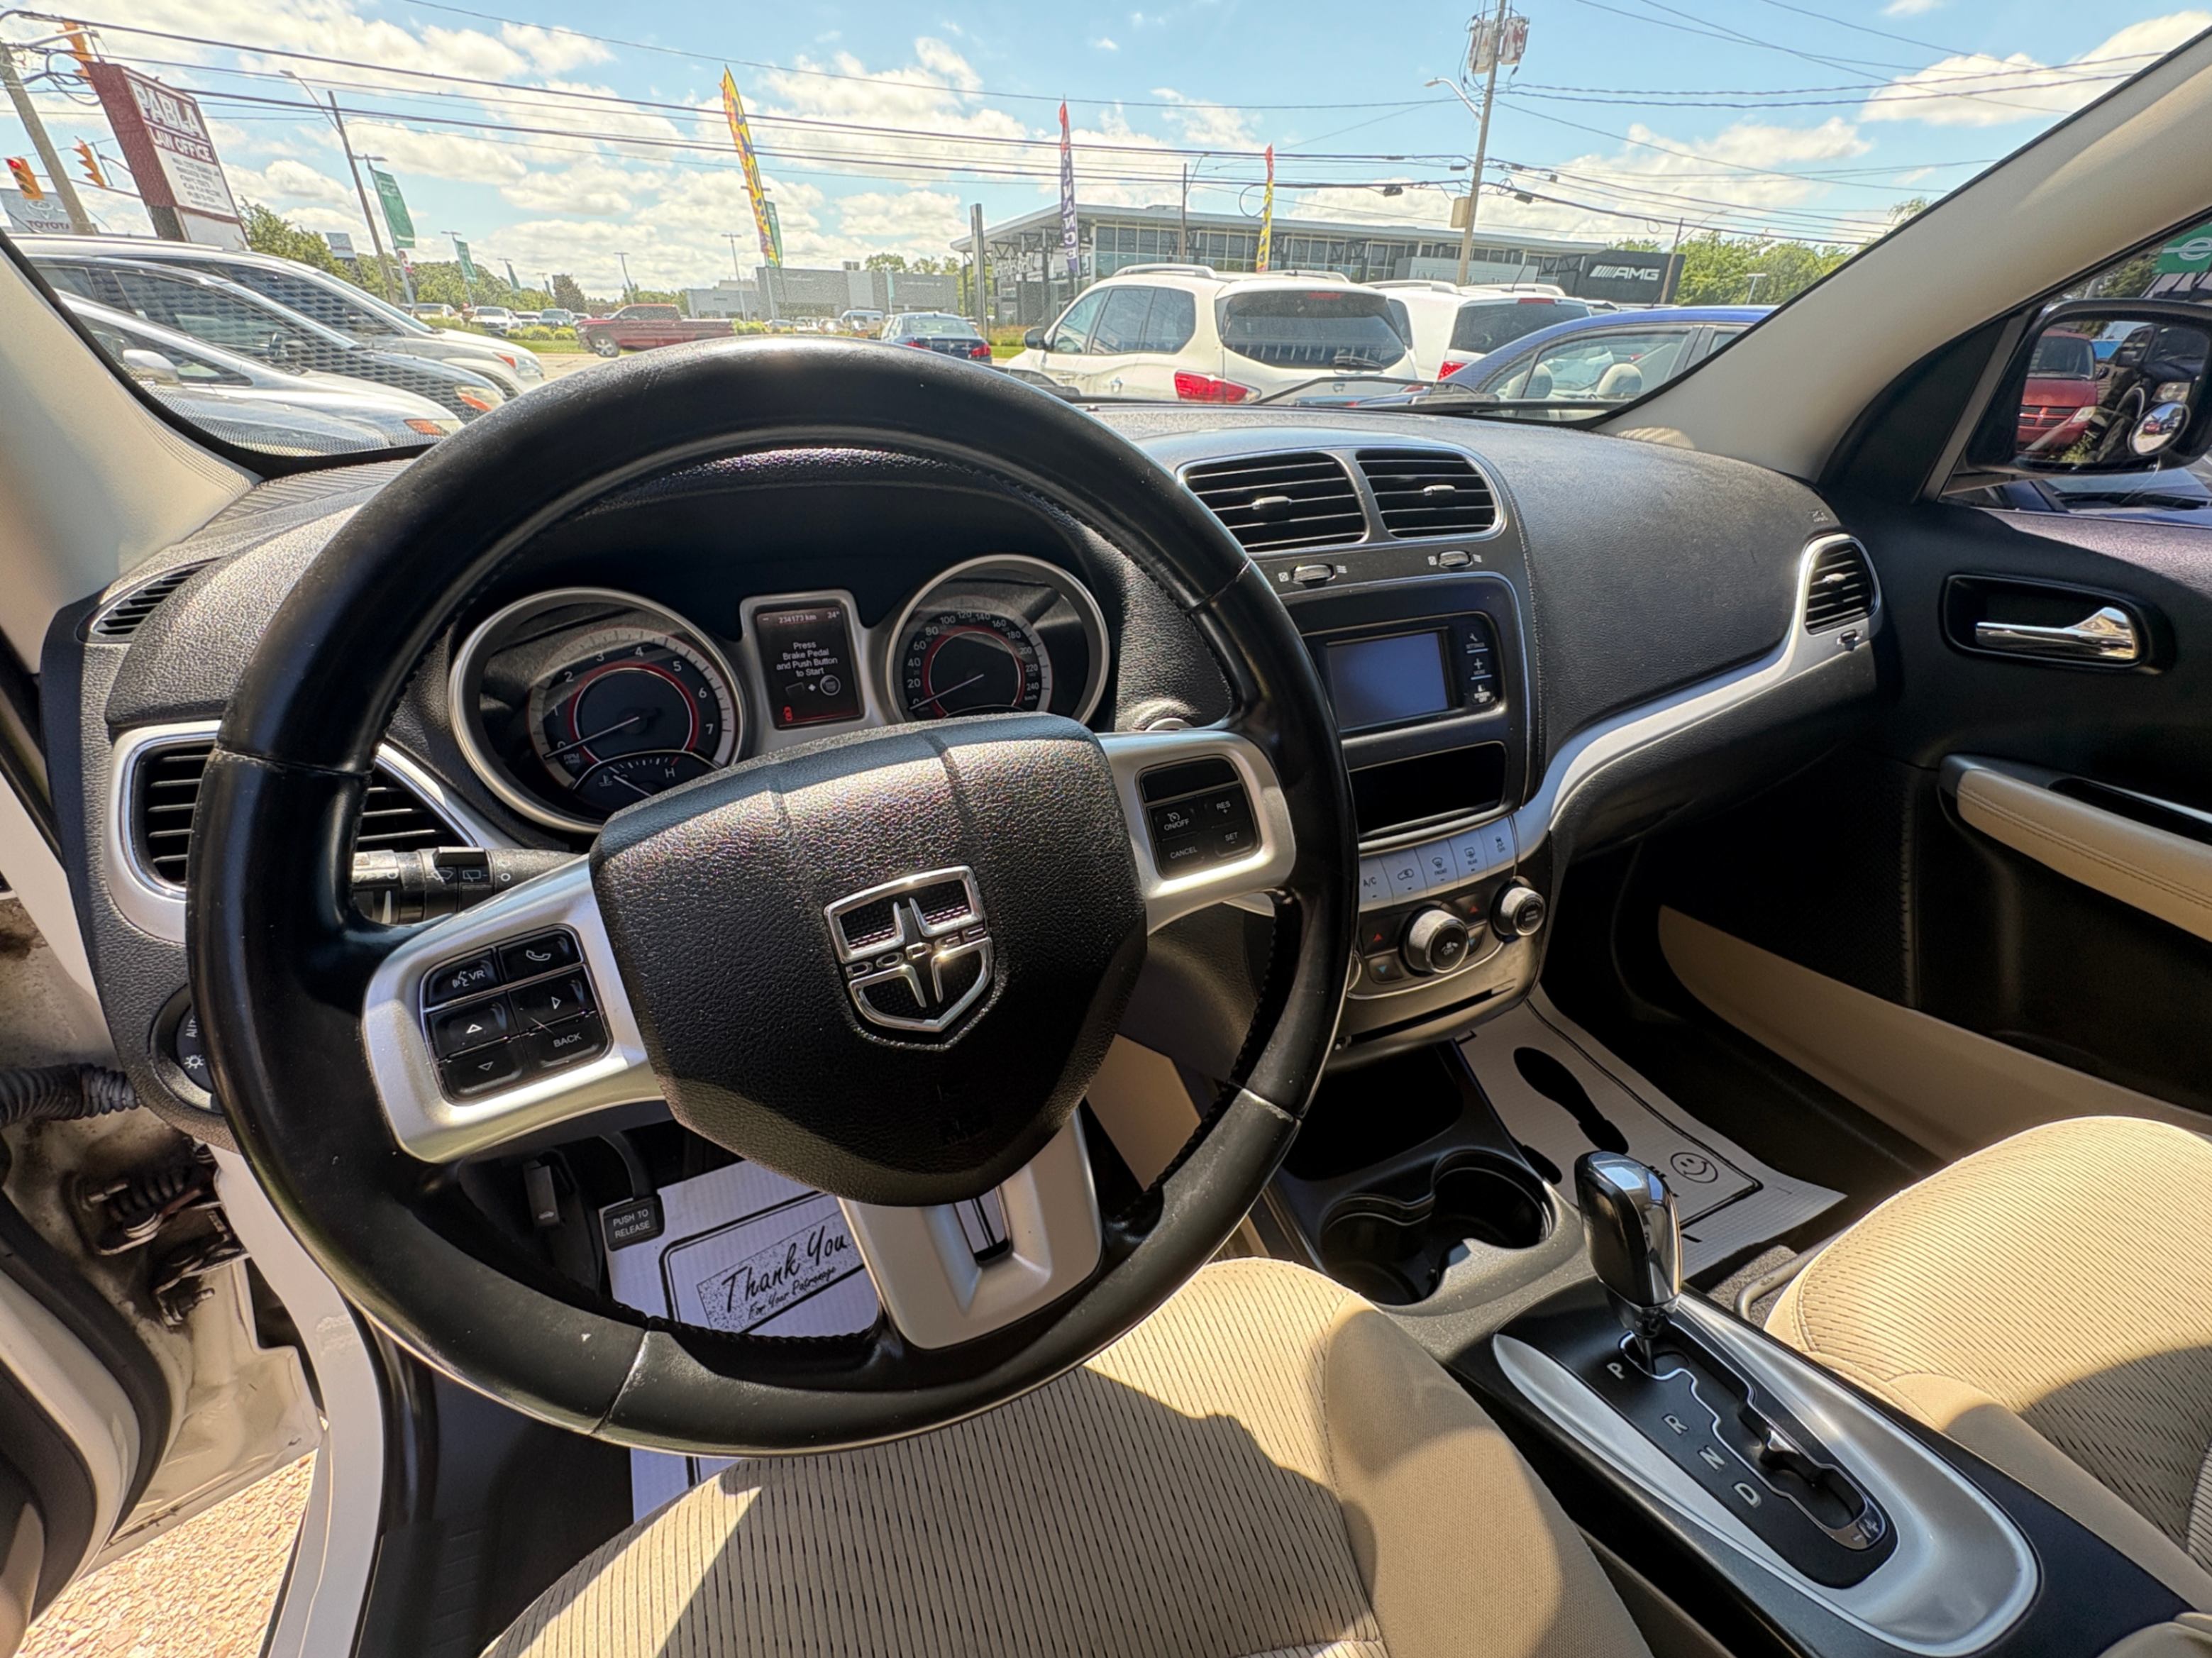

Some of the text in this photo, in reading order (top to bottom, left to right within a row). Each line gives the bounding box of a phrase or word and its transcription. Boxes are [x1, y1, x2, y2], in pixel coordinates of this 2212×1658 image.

[129, 81, 206, 140] PABLA
[149, 126, 212, 162] LAW OFFICE
[1613, 265, 1661, 282] AMG
[940, 615, 956, 624] 100
[925, 626, 939, 636] 80
[634, 646, 644, 657] 4
[792, 641, 817, 650] Press
[913, 641, 927, 651] 60
[596, 652, 605, 661] 3
[783, 648, 829, 661] Brake Pedal
[673, 661, 682, 672] 5
[776, 657, 838, 670] and Push Button
[907, 657, 921, 667] 40
[564, 671, 574, 682] 2
[805, 667, 825, 676] Start
[907, 678, 922, 688] 20
[698, 687, 707, 699] 6
[705, 723, 714, 735] 7
[664, 767, 675, 778] H
[1216, 800, 1231, 810] RES
[1163, 818, 1190, 831] ON/OFF
[1225, 831, 1239, 842] SET
[1171, 846, 1198, 859] CANCEL
[1363, 876, 1377, 887] A/C
[845, 925, 988, 979] DODGE
[468, 969, 486, 981] VR
[185, 1015, 198, 1038] AUT
[553, 1032, 582, 1048] BACK
[612, 1208, 648, 1227] PUSH TO
[614, 1220, 651, 1239] RELEASE
[721, 1225, 848, 1313] Thank You
[748, 1266, 836, 1320] For Your Patronage
[1605, 1361, 1625, 1381] P
[1662, 1414, 1688, 1436] R
[1698, 1445, 1726, 1472] N
[1732, 1481, 1762, 1508] D
